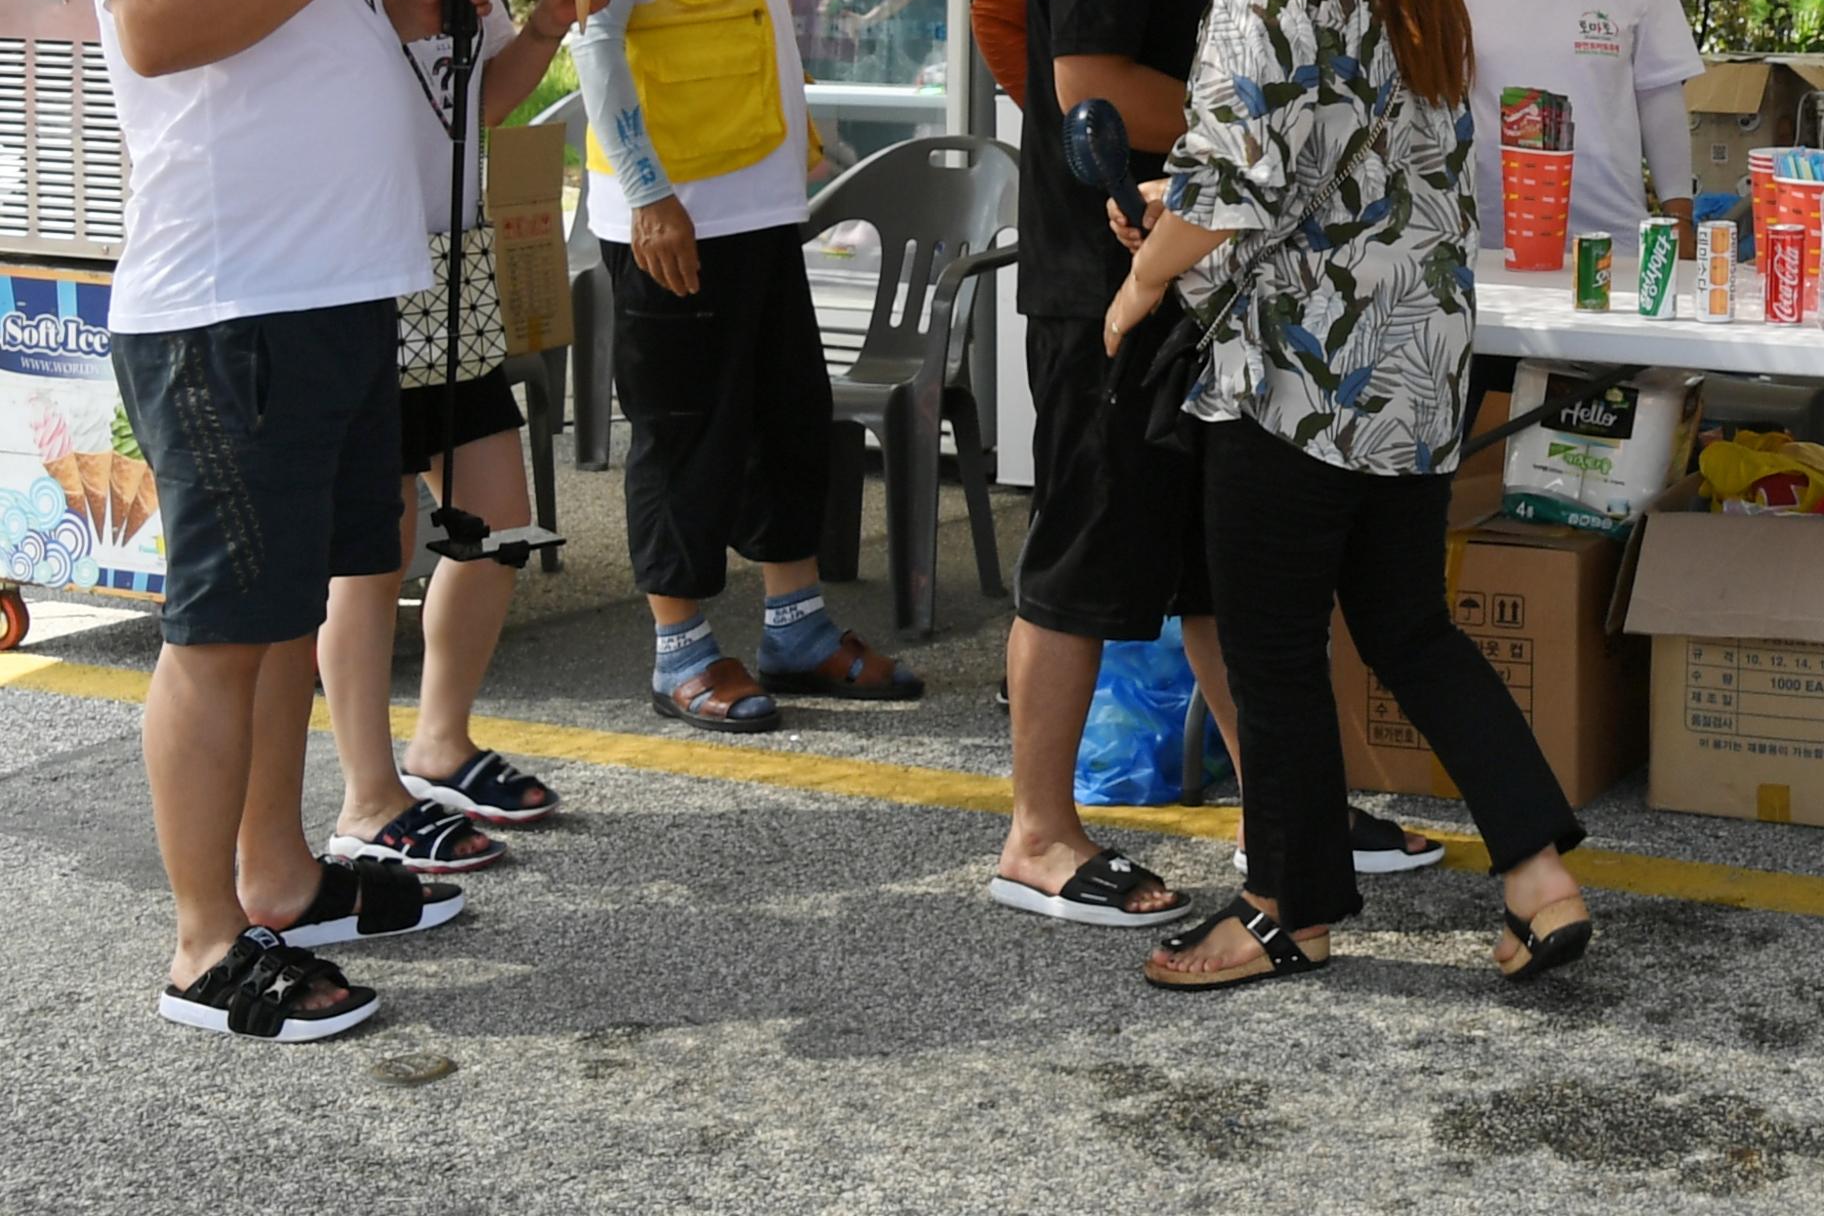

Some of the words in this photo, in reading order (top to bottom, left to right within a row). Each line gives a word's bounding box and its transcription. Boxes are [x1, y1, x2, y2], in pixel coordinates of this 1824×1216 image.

[4, 315, 59, 350] Soft
[64, 319, 110, 354] Ice
[1561, 400, 1618, 427] Hello
[1770, 677, 1801, 692] 1000
[1805, 679, 1824, 693] EA
